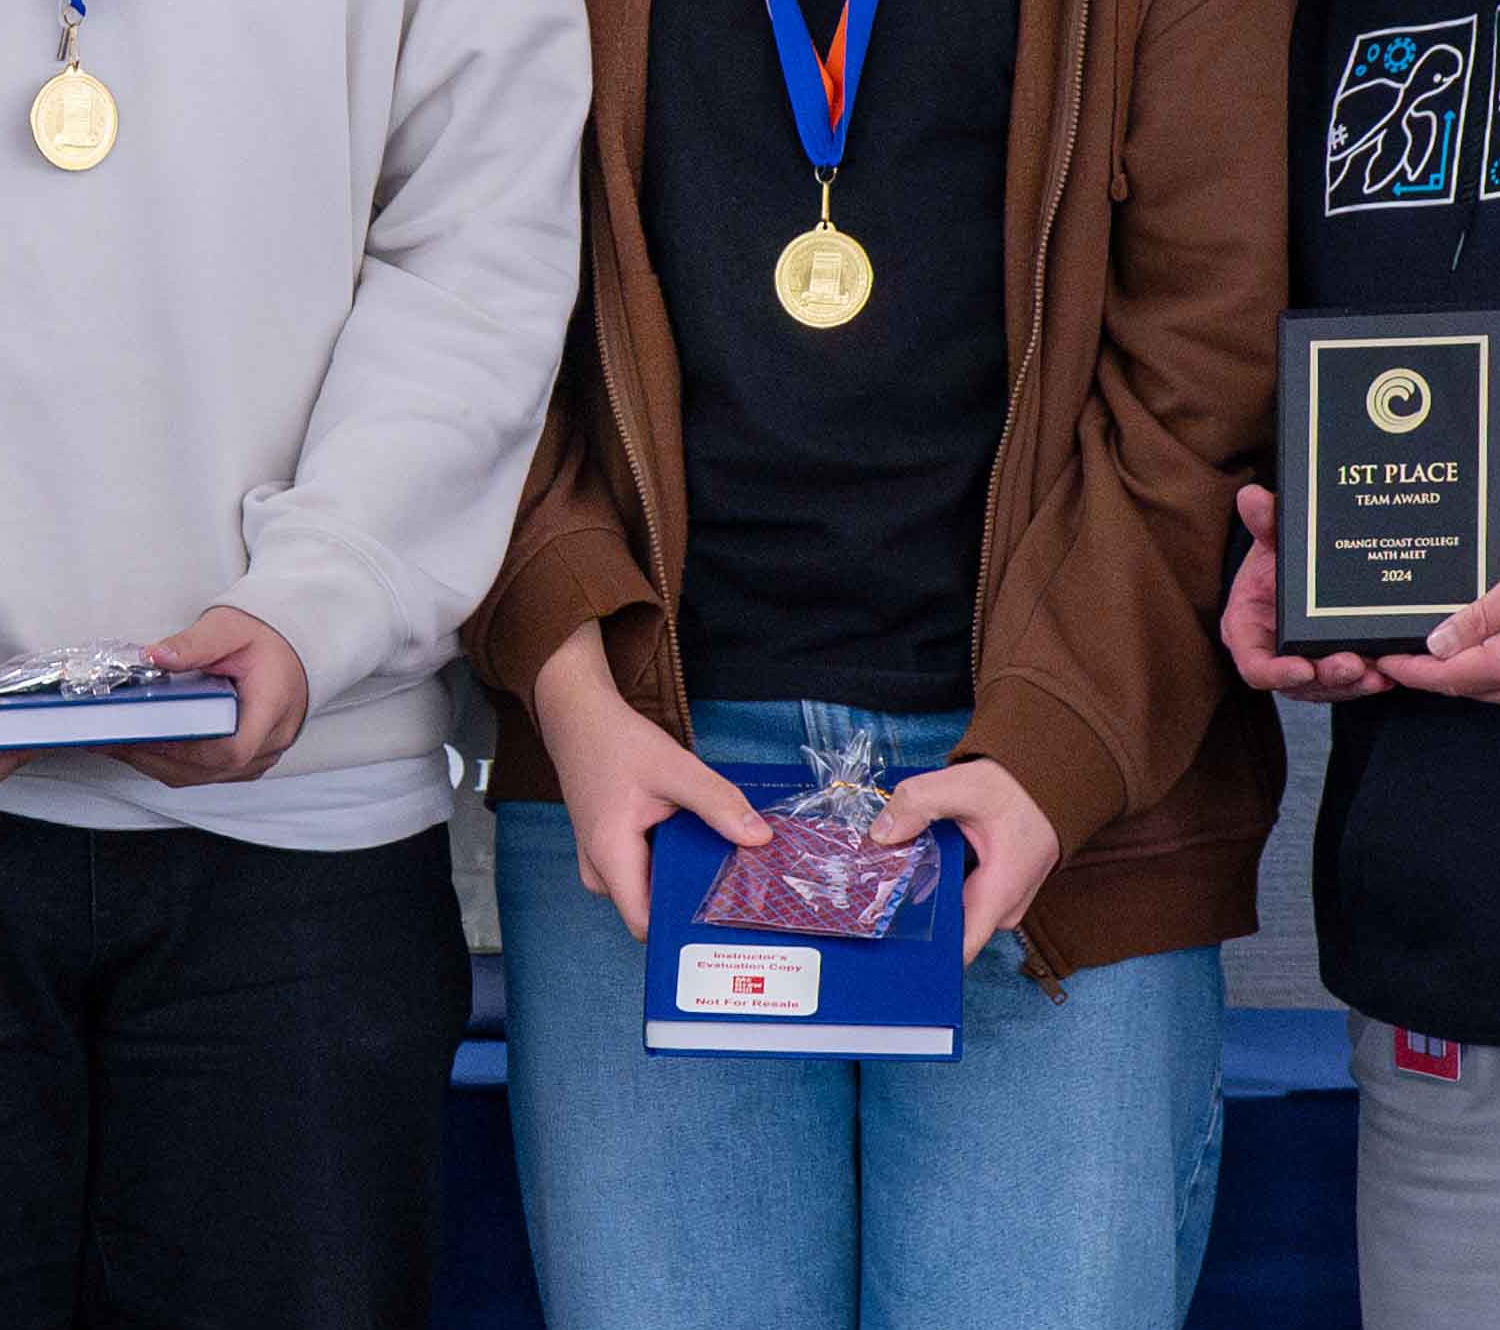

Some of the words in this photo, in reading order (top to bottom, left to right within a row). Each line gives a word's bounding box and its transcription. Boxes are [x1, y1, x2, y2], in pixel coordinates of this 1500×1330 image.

[1337, 464, 1378, 485] 1ST
[1384, 462, 1459, 484] PLACE
[1355, 494, 1391, 506] TEAM
[1393, 492, 1441, 505] AWARD
[1335, 538, 1377, 550] ORANGE
[1379, 538, 1413, 549] COAST
[1414, 536, 1460, 548] COLLEGE
[1367, 551, 1398, 561] MATH
[1399, 550, 1427, 560] MEET
[1381, 570, 1413, 582] 2024
[697, 961, 765, 972] Evaluation
[769, 963, 803, 973] Copy
[695, 997, 720, 1007] Not
[724, 998, 747, 1007] For
[752, 999, 799, 1009] Resale
